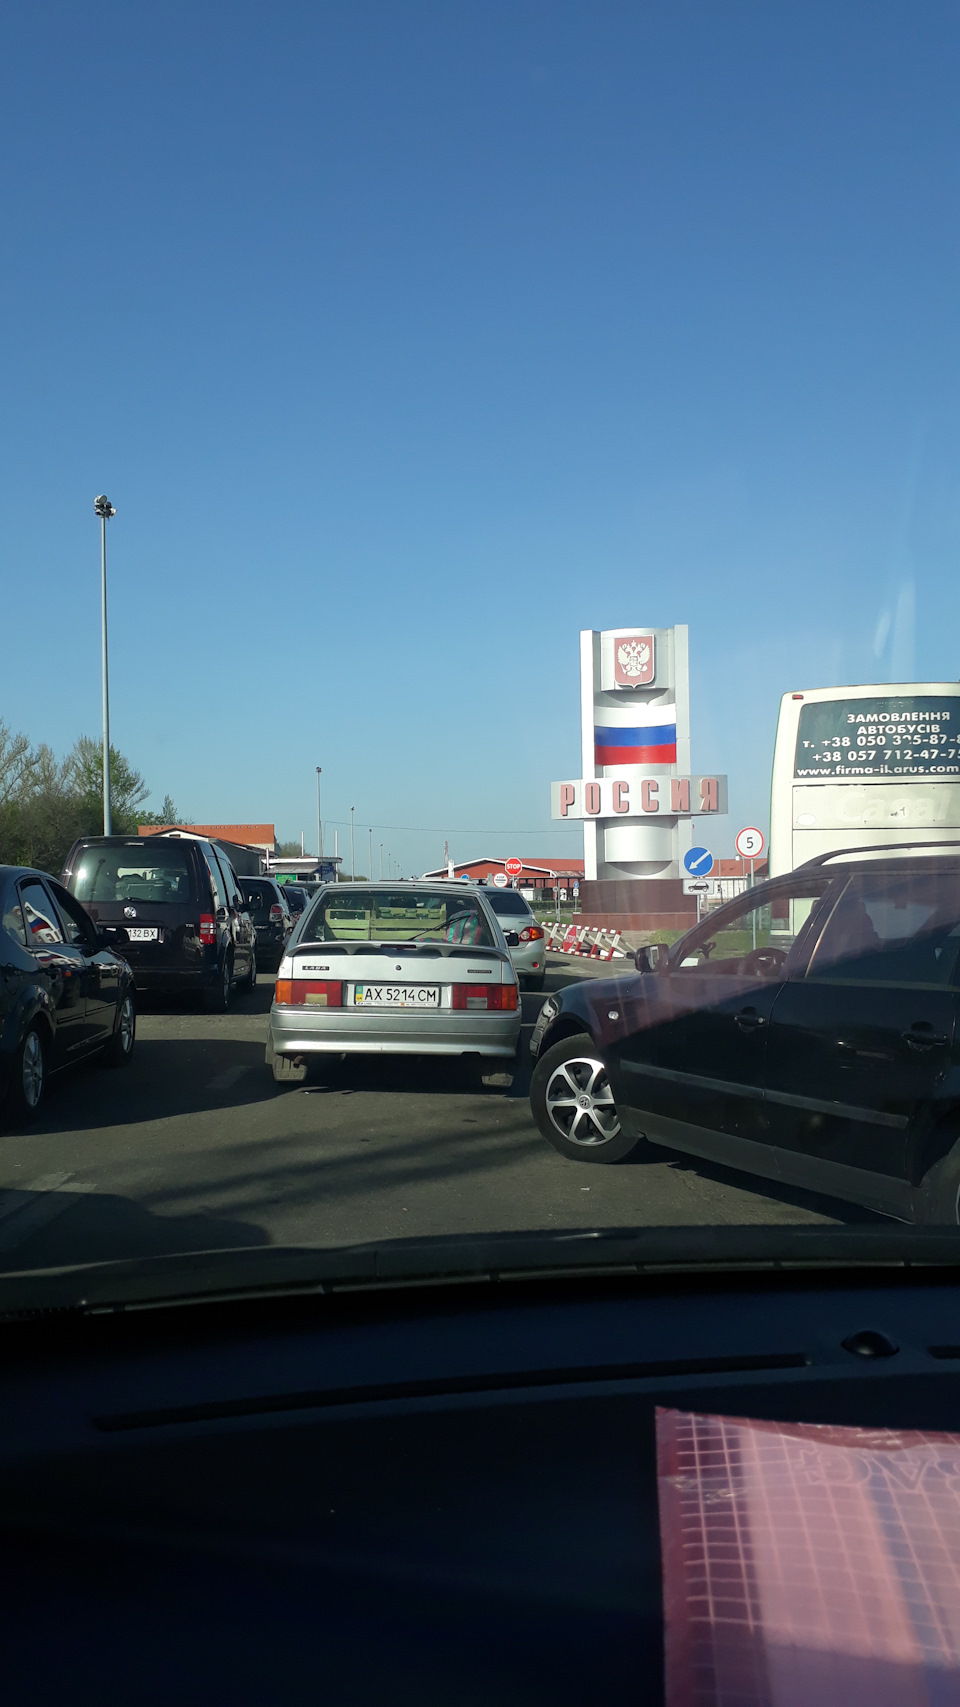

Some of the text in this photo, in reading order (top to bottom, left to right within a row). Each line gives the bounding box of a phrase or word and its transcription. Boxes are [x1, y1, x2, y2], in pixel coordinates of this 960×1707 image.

[847, 711, 951, 723] ЗАМОВЛЕННЯ
[857, 724, 941, 735] АВТОБУСІВ
[821, 736, 851, 747] +38
[857, 735, 886, 746] 050
[812, 751, 842, 762] +38
[848, 750, 877, 761] 057
[797, 764, 959, 776] www.firma-ikarus.com
[560, 778, 719, 816] РОССИЯ
[746, 836, 754, 849] 5
[143, 930, 155, 938] BX
[364, 988, 436, 1002] AX 5214 CM
